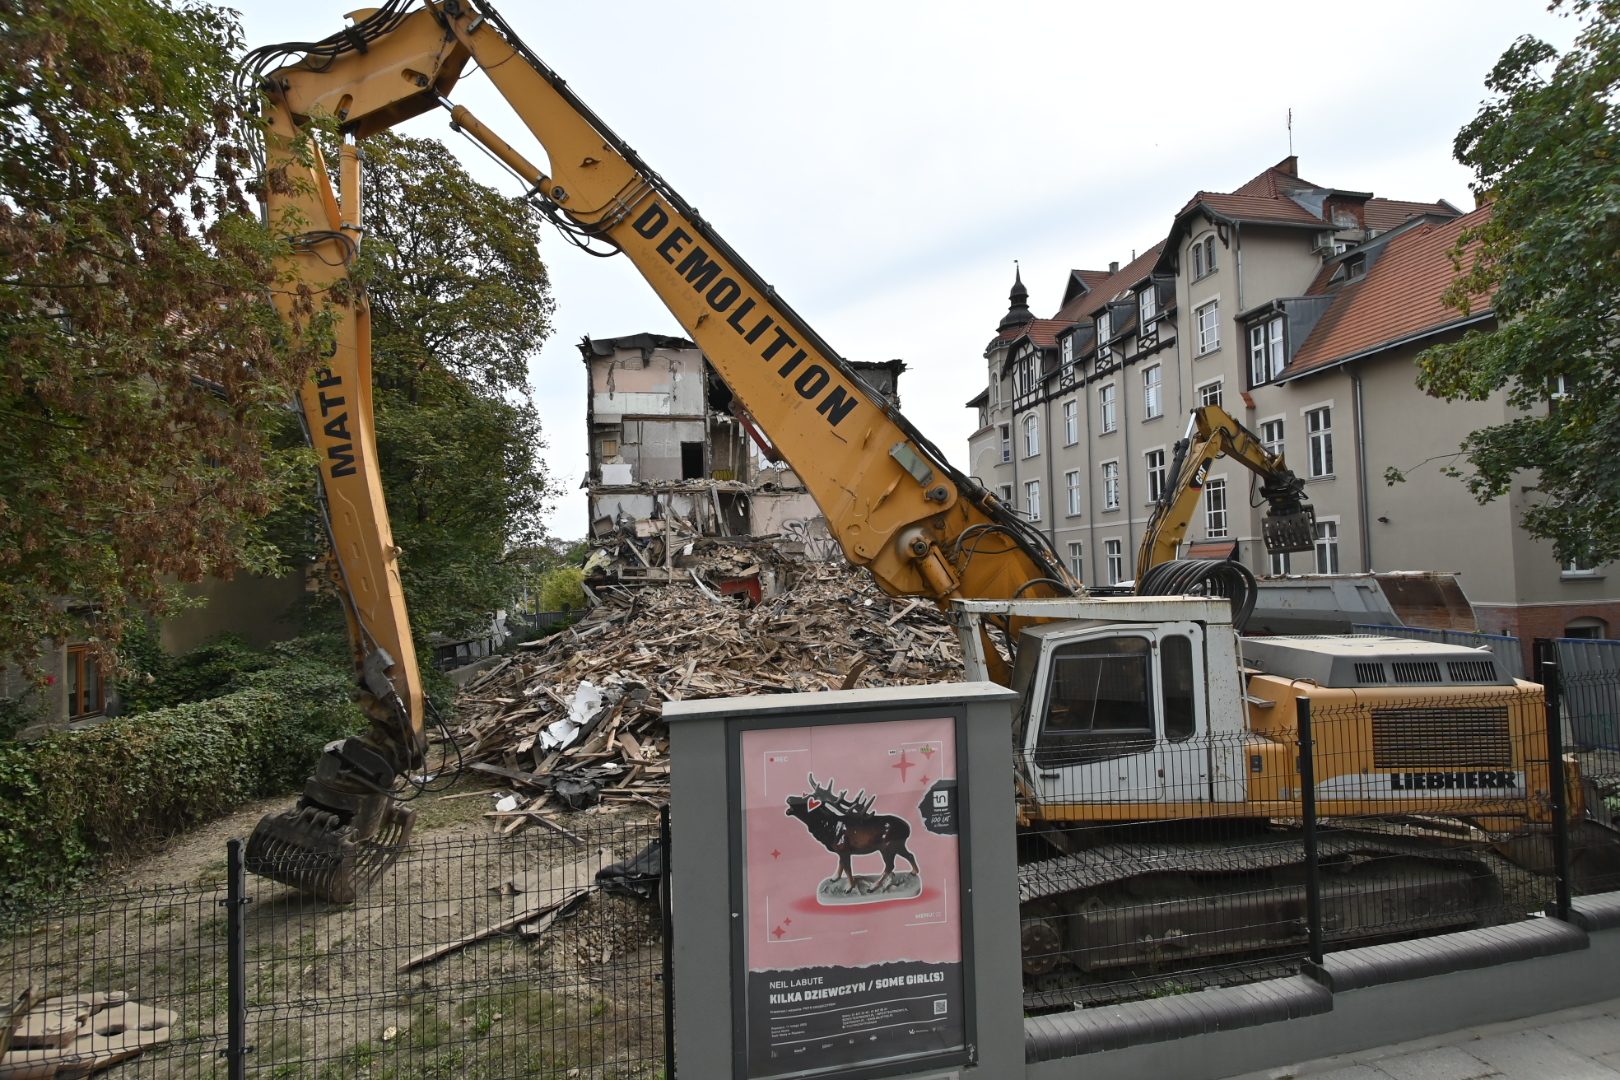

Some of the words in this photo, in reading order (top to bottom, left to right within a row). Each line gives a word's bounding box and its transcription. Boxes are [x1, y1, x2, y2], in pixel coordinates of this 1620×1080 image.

[631, 202, 859, 427] DEMOLITION
[1195, 464, 1207, 485] CAT
[1391, 771, 1516, 790] LIEBHERR
[769, 981, 788, 989] NEIL
[790, 977, 824, 987] LABUTE
[769, 992, 802, 1004] KILKA
[804, 982, 866, 1000] DZIEWCZYN
[875, 976, 904, 989] SOME
[906, 971, 944, 985] GIRL(S)
